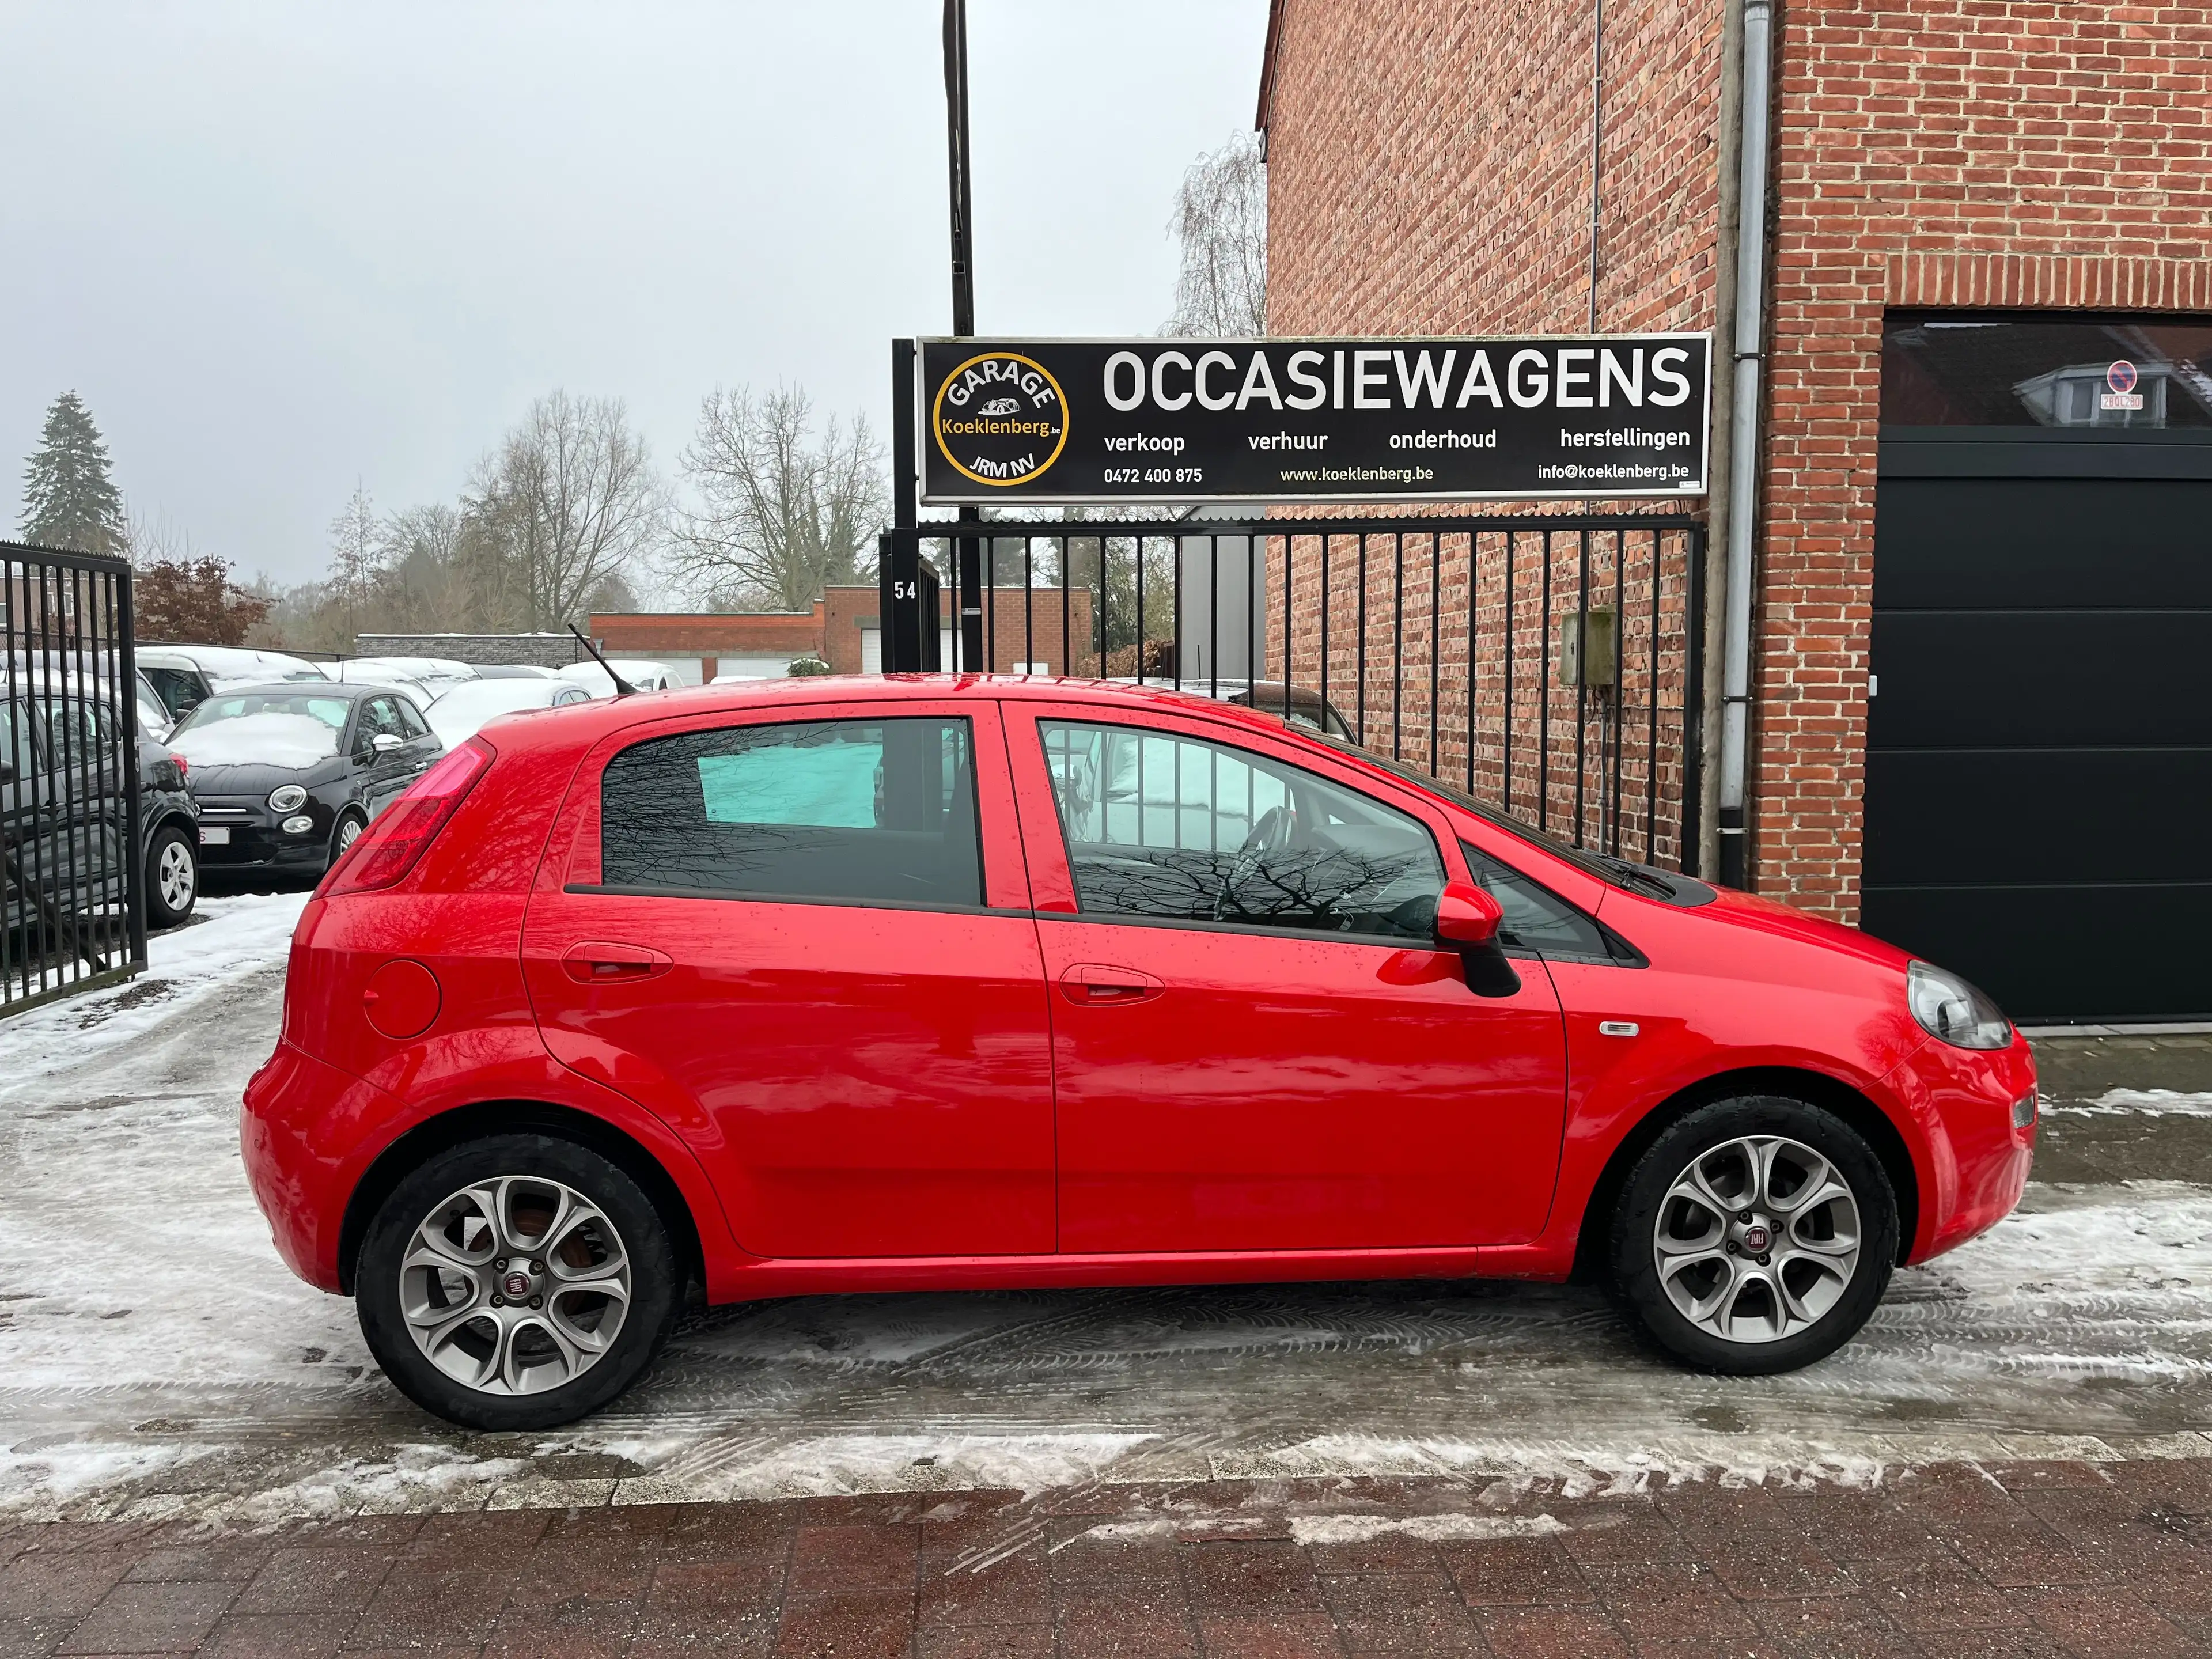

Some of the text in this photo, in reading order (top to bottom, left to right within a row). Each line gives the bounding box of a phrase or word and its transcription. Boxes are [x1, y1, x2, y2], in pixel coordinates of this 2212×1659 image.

[948, 360, 1055, 408] GARAGE
[1104, 347, 1690, 411] OCCASIEWAGENS
[1104, 432, 1185, 456] verkoop
[1248, 431, 1329, 450] verhuur
[1389, 429, 1496, 448] onderhoud
[1560, 427, 1690, 450] herstellingen
[969, 453, 1035, 478] JRM NV
[1280, 465, 1434, 483] www.koeklenberg.be
[1538, 463, 1690, 481] info@koeklenberg.be
[1104, 468, 1202, 483] 0472 400 875
[895, 581, 916, 599] 54
[1751, 1233, 1763, 1244] FIAT
[509, 1278, 522, 1292] FIAT
